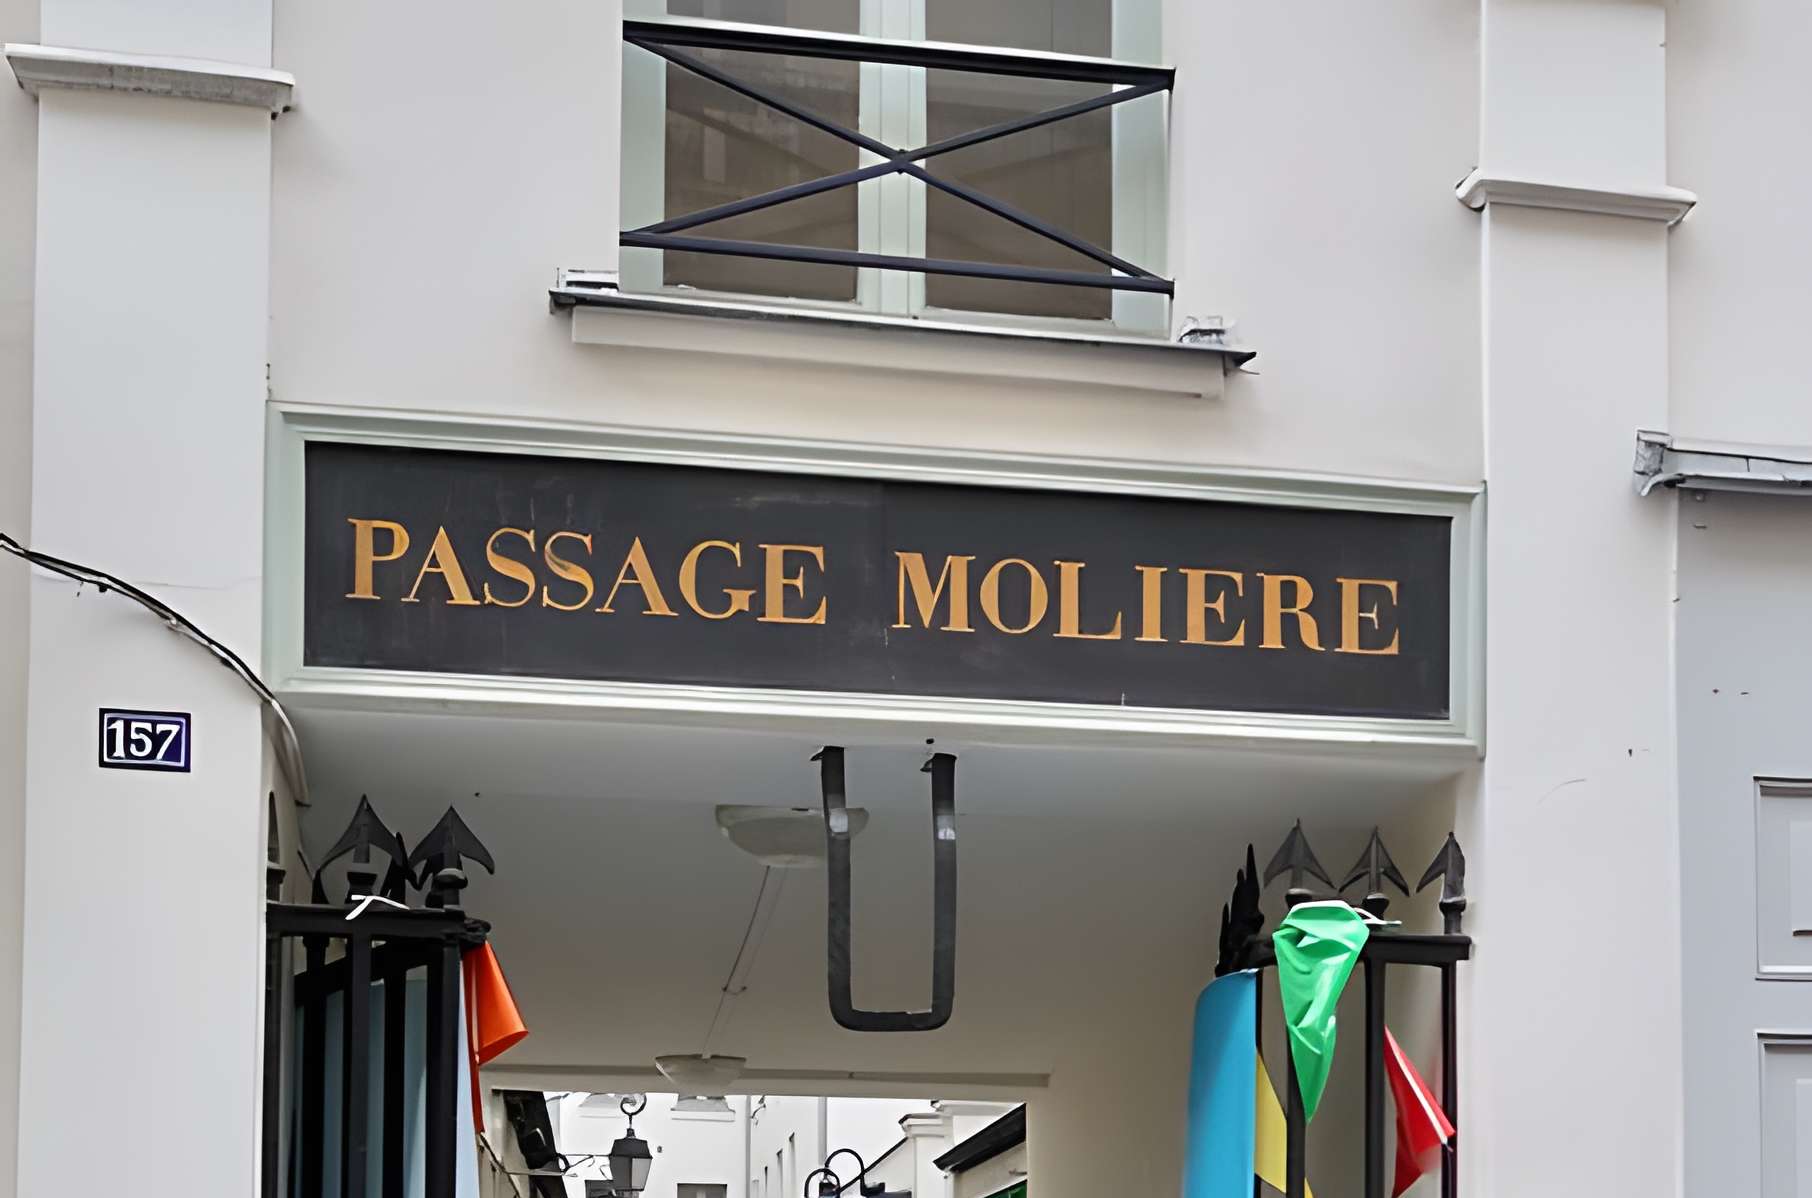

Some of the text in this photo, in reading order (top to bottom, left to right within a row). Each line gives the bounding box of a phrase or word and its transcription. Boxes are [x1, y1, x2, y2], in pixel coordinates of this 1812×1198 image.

[345, 518, 1400, 655] PASSAGE MOLIERE
[107, 720, 181, 761] 157
